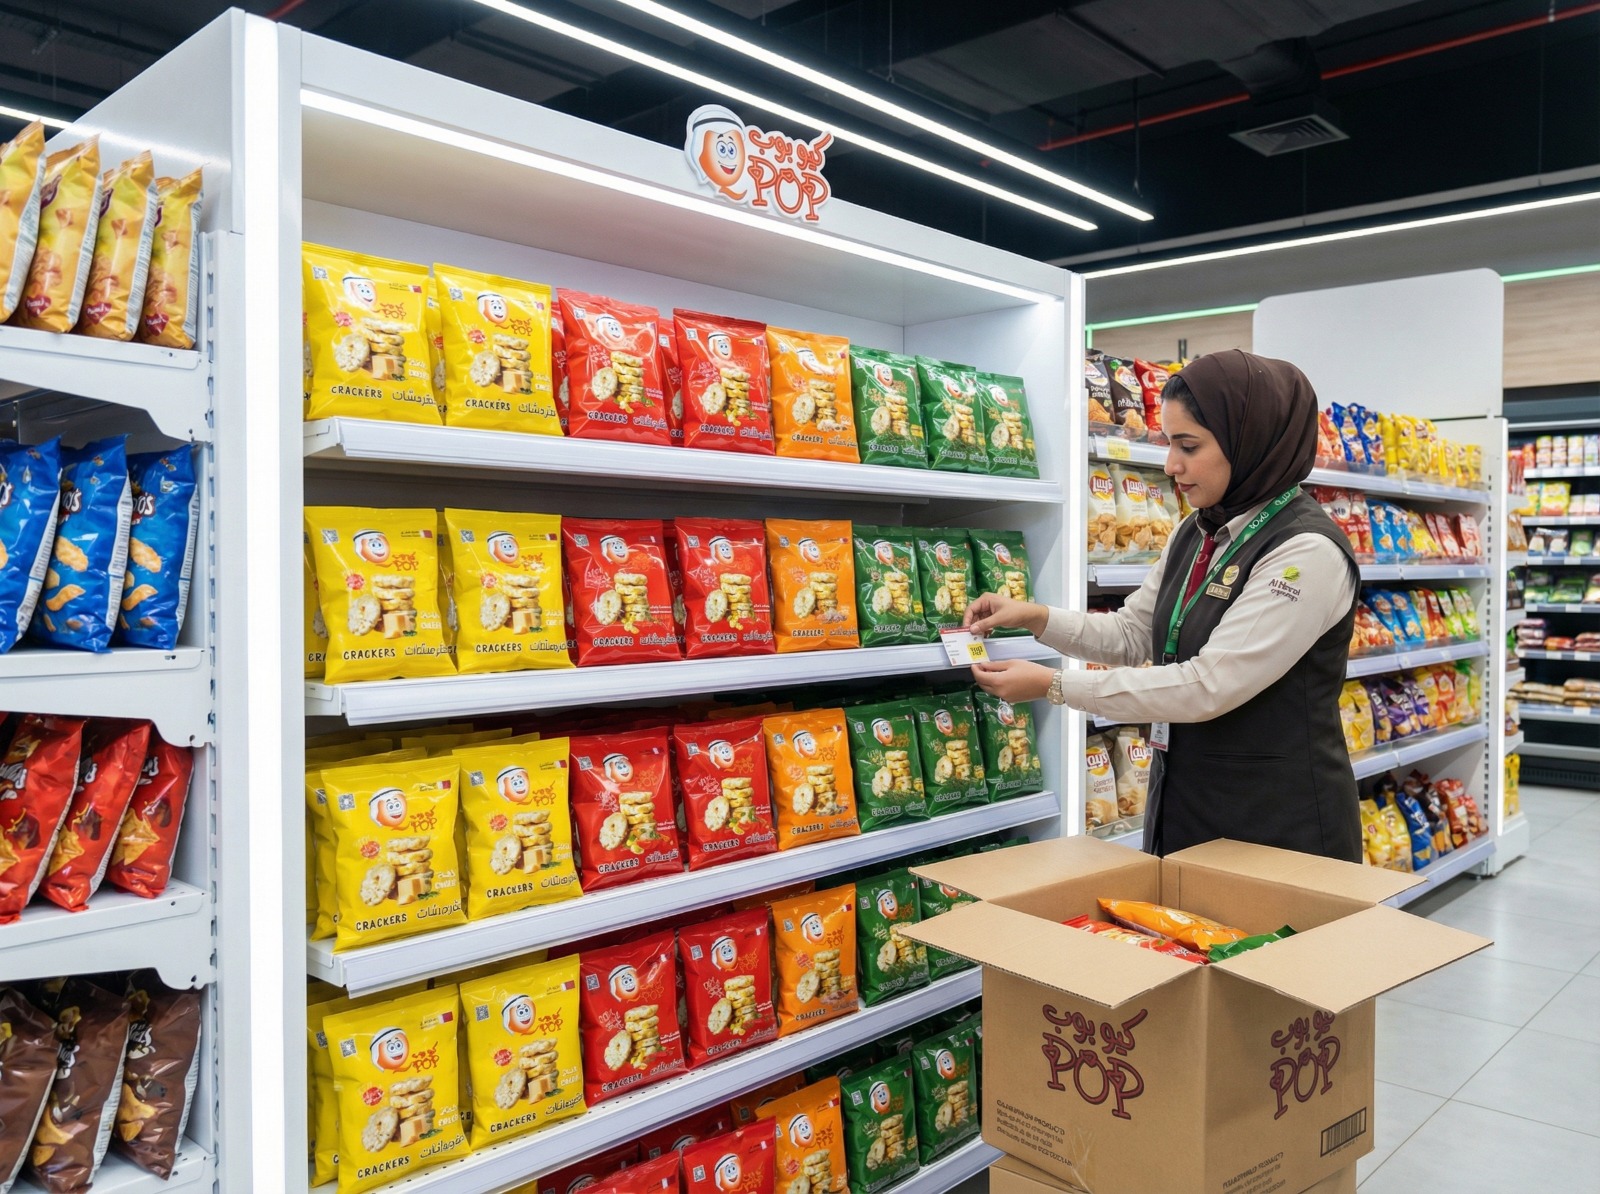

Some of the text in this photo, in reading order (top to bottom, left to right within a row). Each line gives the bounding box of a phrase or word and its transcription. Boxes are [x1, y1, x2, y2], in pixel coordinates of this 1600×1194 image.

[747, 155, 829, 221] POP
[331, 385, 383, 399] CRACKERS
[465, 398, 511, 411] CRACKERS
[343, 648, 396, 660] CRACKERS
[476, 643, 522, 653] CRACKERS
[486, 882, 534, 898] CRACKERS
[356, 913, 408, 931] CRACKERS
[1041, 1031, 1145, 1120] POP
[1269, 1035, 1341, 1121] POP
[489, 1112, 538, 1133] CRACKERS
[357, 1155, 410, 1179] CRACKERS
